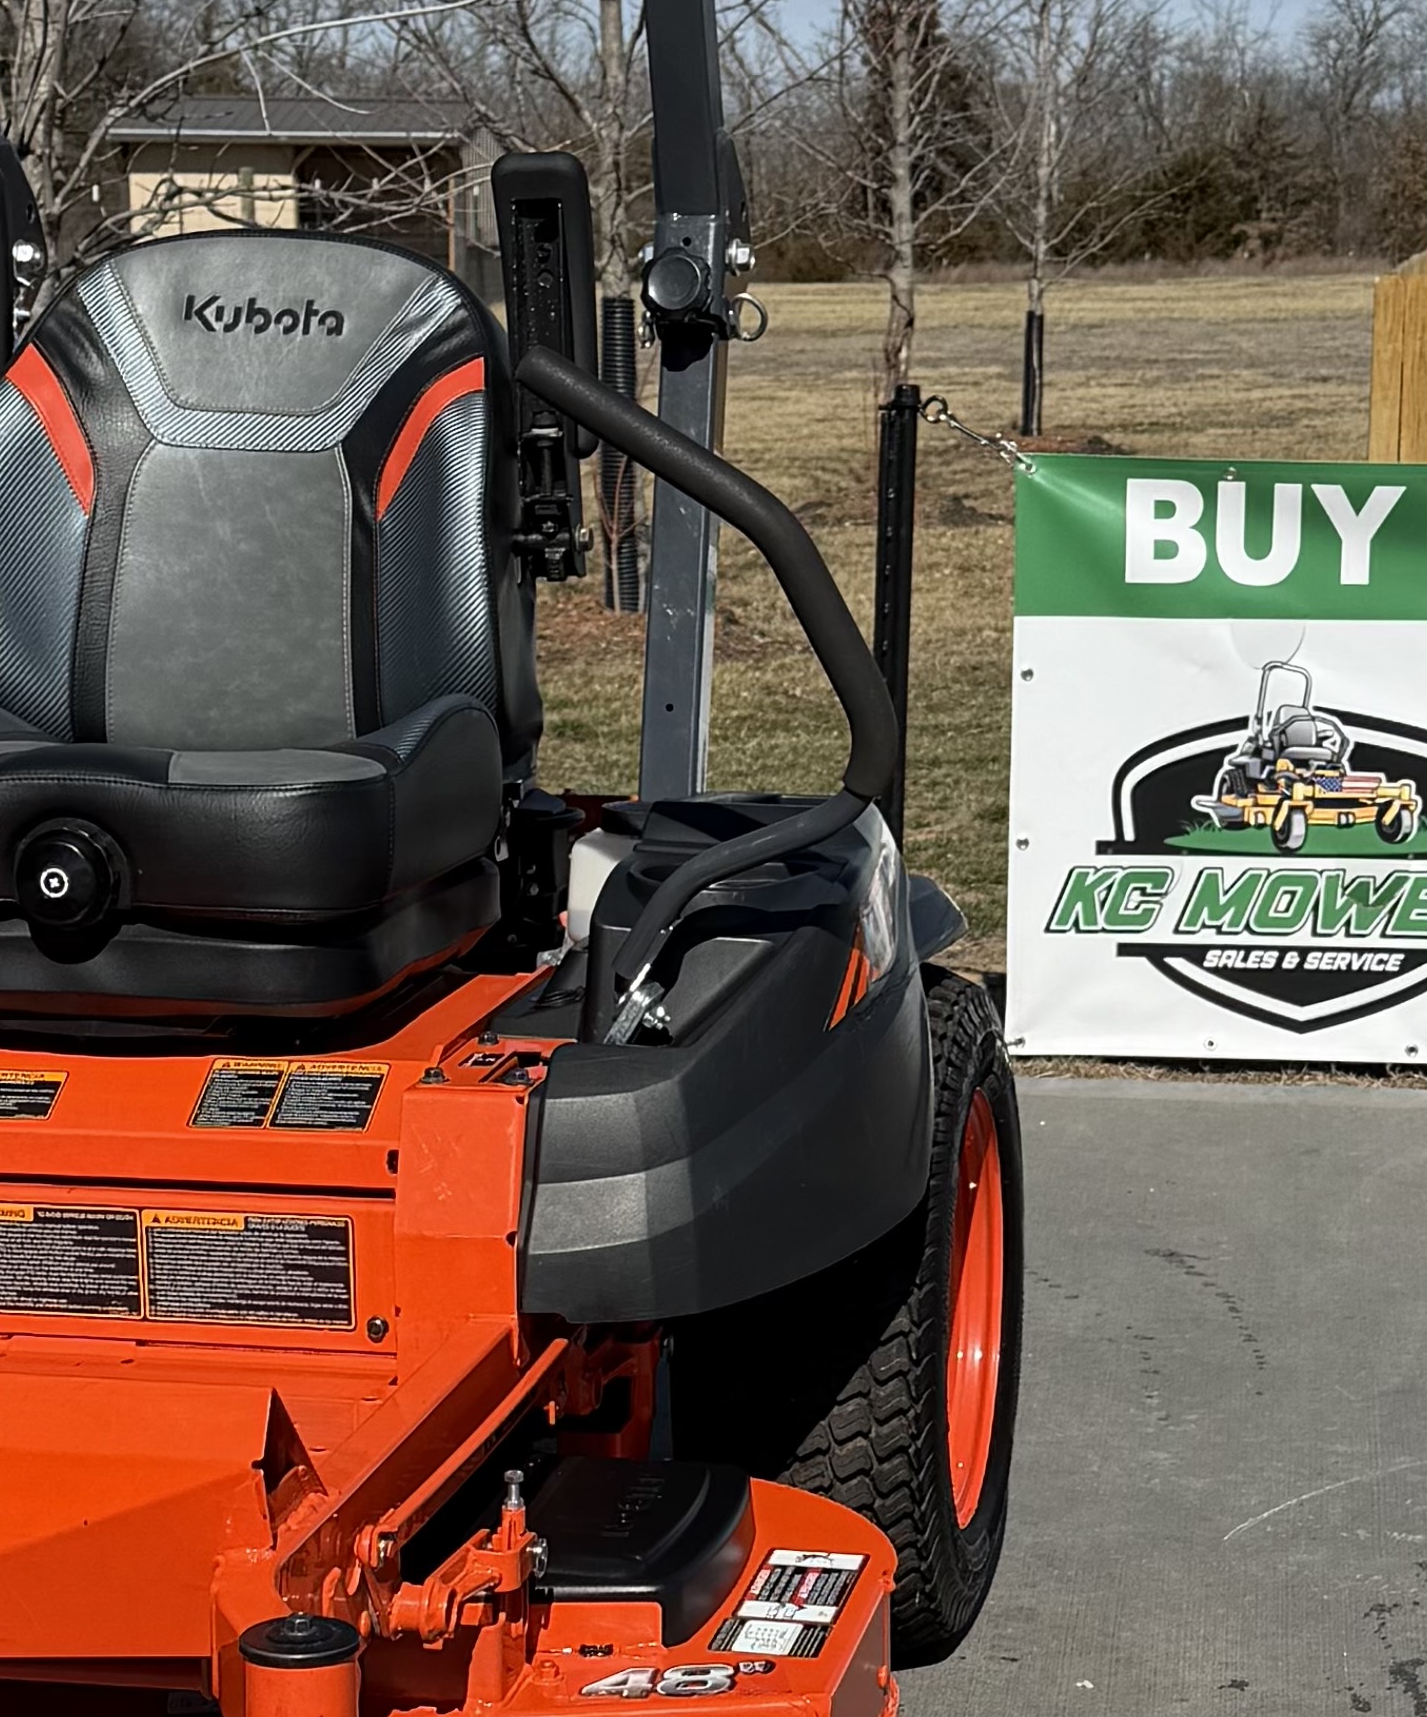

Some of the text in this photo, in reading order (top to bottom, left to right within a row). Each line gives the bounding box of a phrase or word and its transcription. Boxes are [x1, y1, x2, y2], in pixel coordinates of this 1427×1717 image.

[183, 294, 346, 336] Kubota
[1124, 477, 1407, 586] BUY
[1045, 866, 1176, 934] KC
[1203, 949, 1405, 972] SALES & SERVICE
